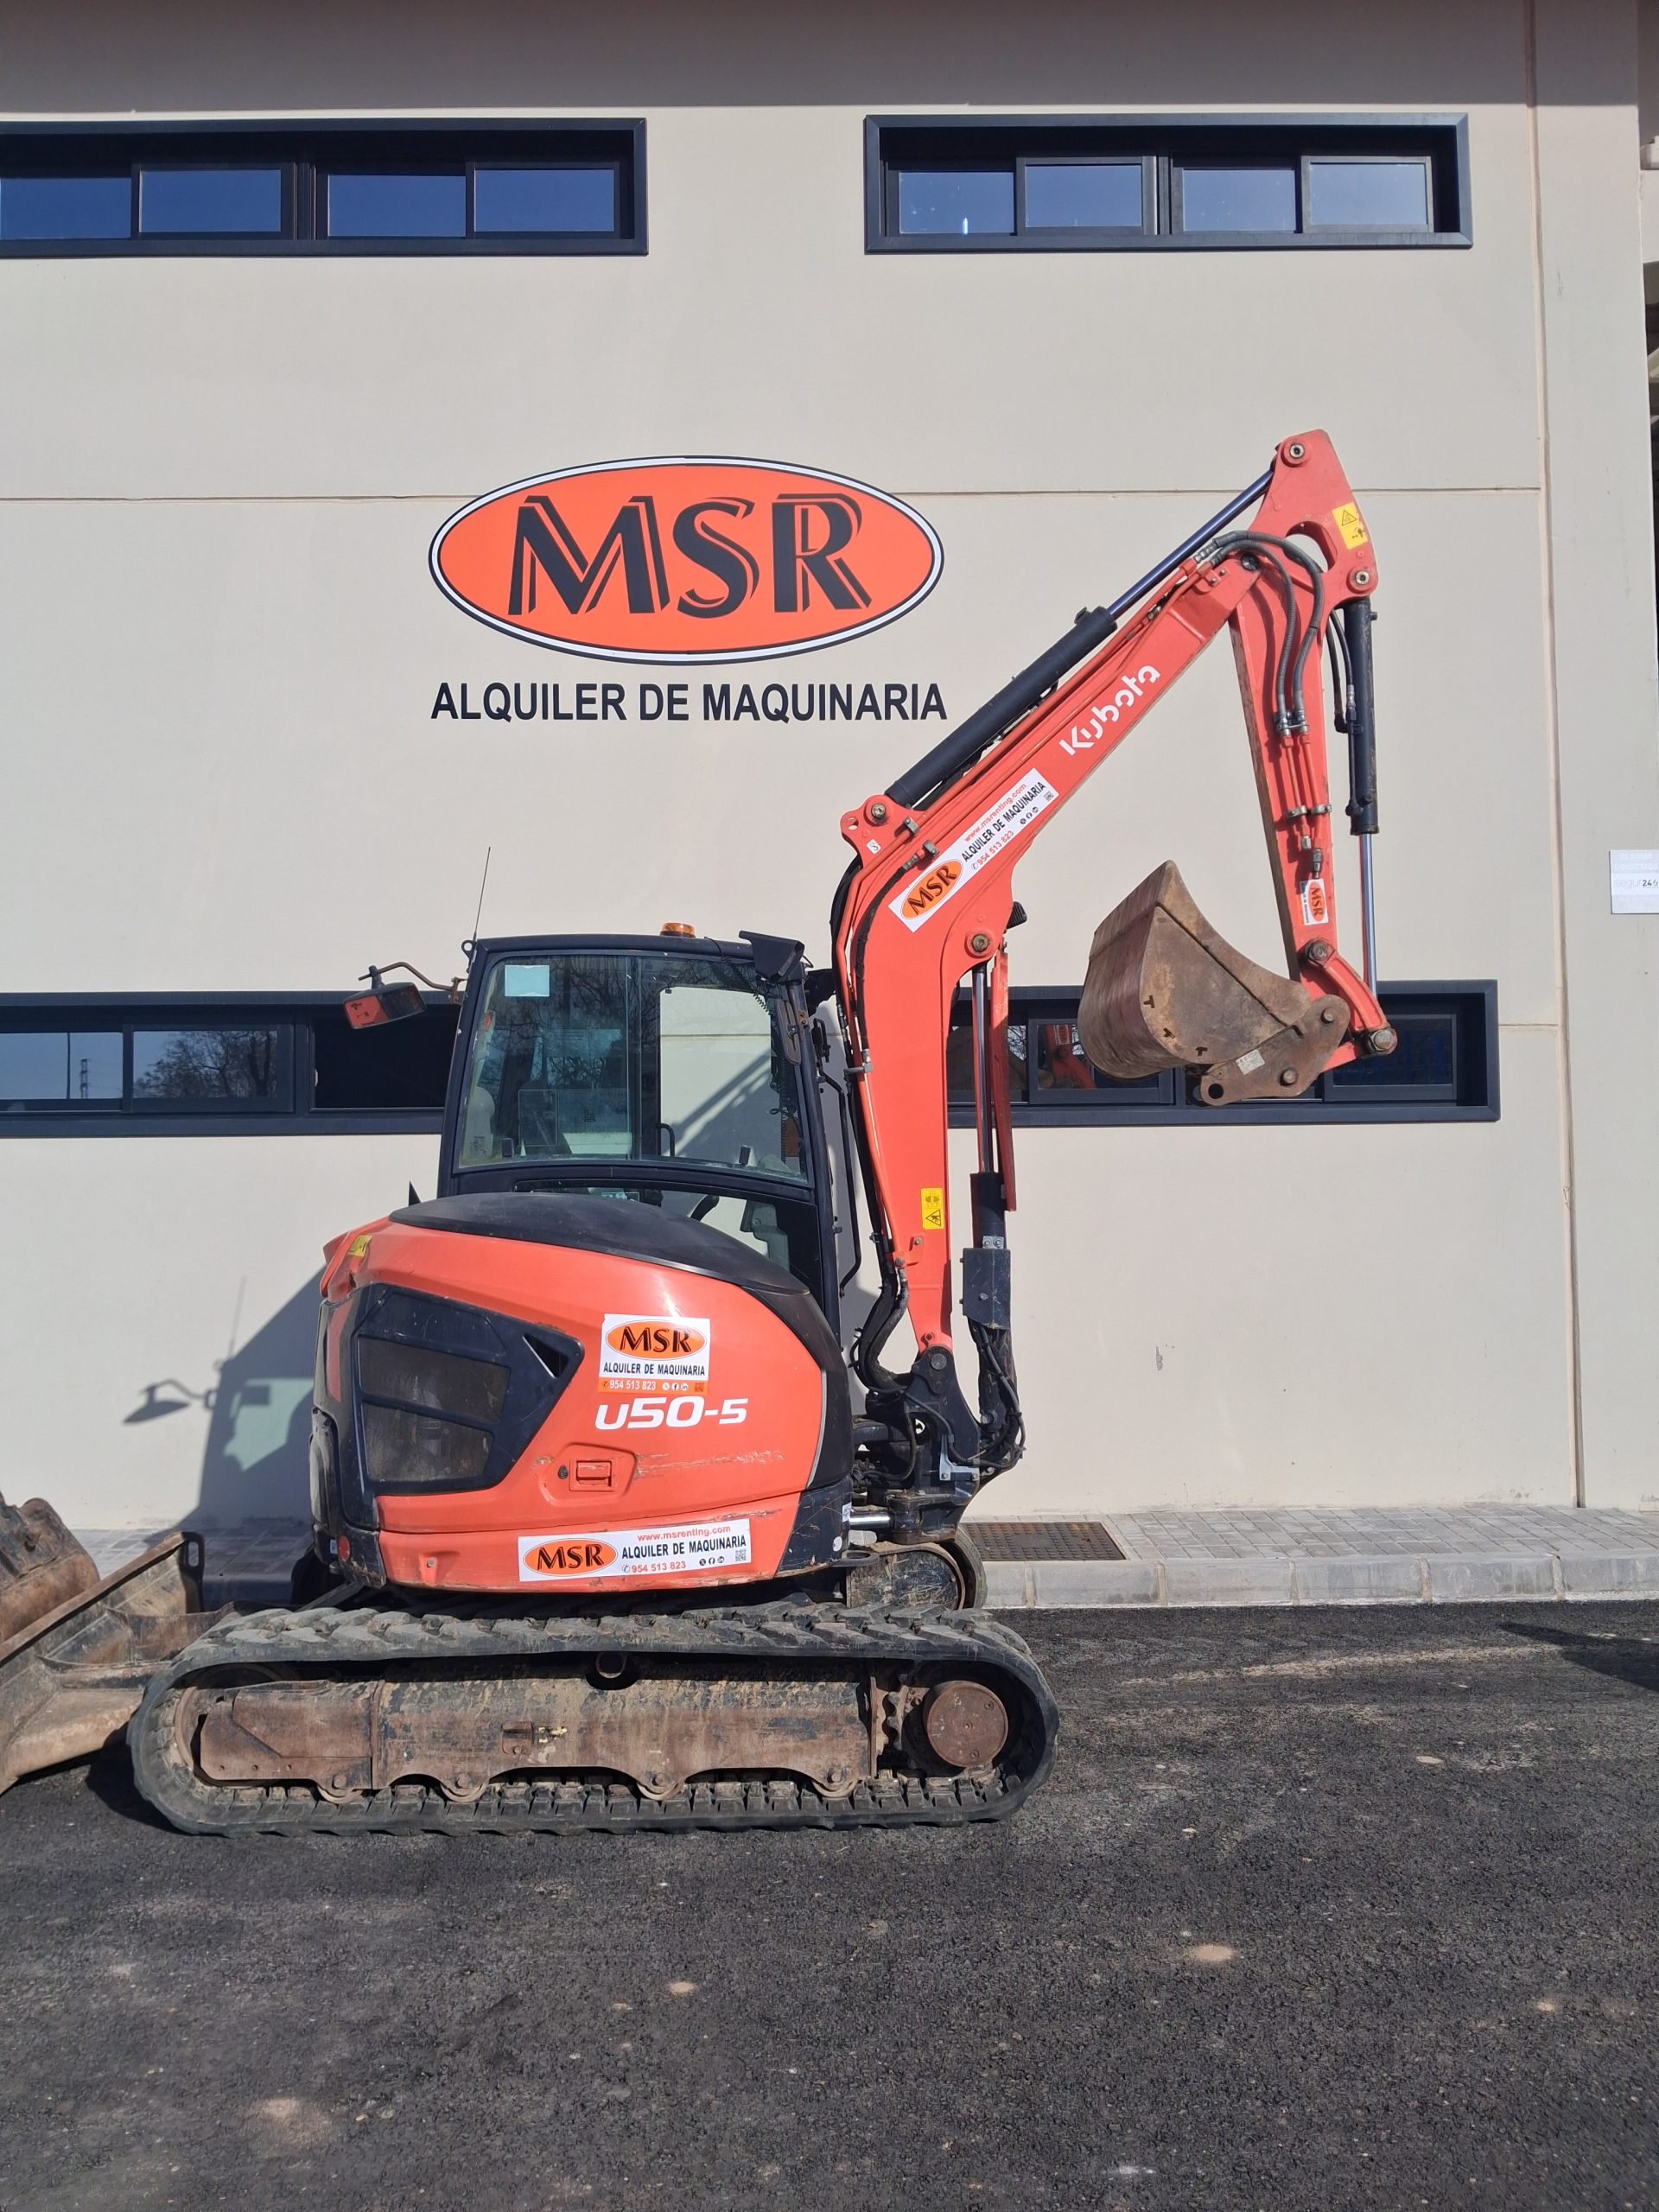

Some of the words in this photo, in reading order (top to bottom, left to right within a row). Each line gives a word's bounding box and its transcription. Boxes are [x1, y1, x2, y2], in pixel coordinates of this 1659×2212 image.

[508, 494, 872, 619] MSR
[430, 682, 627, 722] ALQUILER
[639, 683, 689, 721] DE
[702, 683, 948, 723] MAQUINARIA
[1058, 665, 1160, 756] Kubota
[961, 829, 995, 861] ALQUILER
[993, 818, 1006, 832] DE
[1002, 781, 1046, 823] MAQUINARIA
[964, 783, 1027, 842] www.msrenting.com
[977, 852, 990, 866] 954
[989, 841, 1002, 855] 513
[1001, 830, 1014, 843] 823
[907, 865, 957, 915] MSR
[1310, 887, 1325, 916] MSR
[620, 1326, 691, 1353] MSR
[603, 1363, 641, 1374] ALQUILER
[645, 1364, 654, 1375] DE
[658, 1364, 705, 1376] MAQUINARIA
[610, 1380, 624, 1389] 954
[626, 1380, 640, 1390] 513
[642, 1381, 657, 1390] 823
[621, 1542, 669, 1560] ALQUILER
[672, 1541, 685, 1554] DE
[689, 1535, 747, 1554] MAQUINARIA
[637, 1525, 731, 1542] www.msrenting.com
[537, 1543, 605, 1571] MSR
[632, 1564, 648, 1573] 954
[651, 1561, 667, 1571] 513
[670, 1560, 686, 1570] 823
